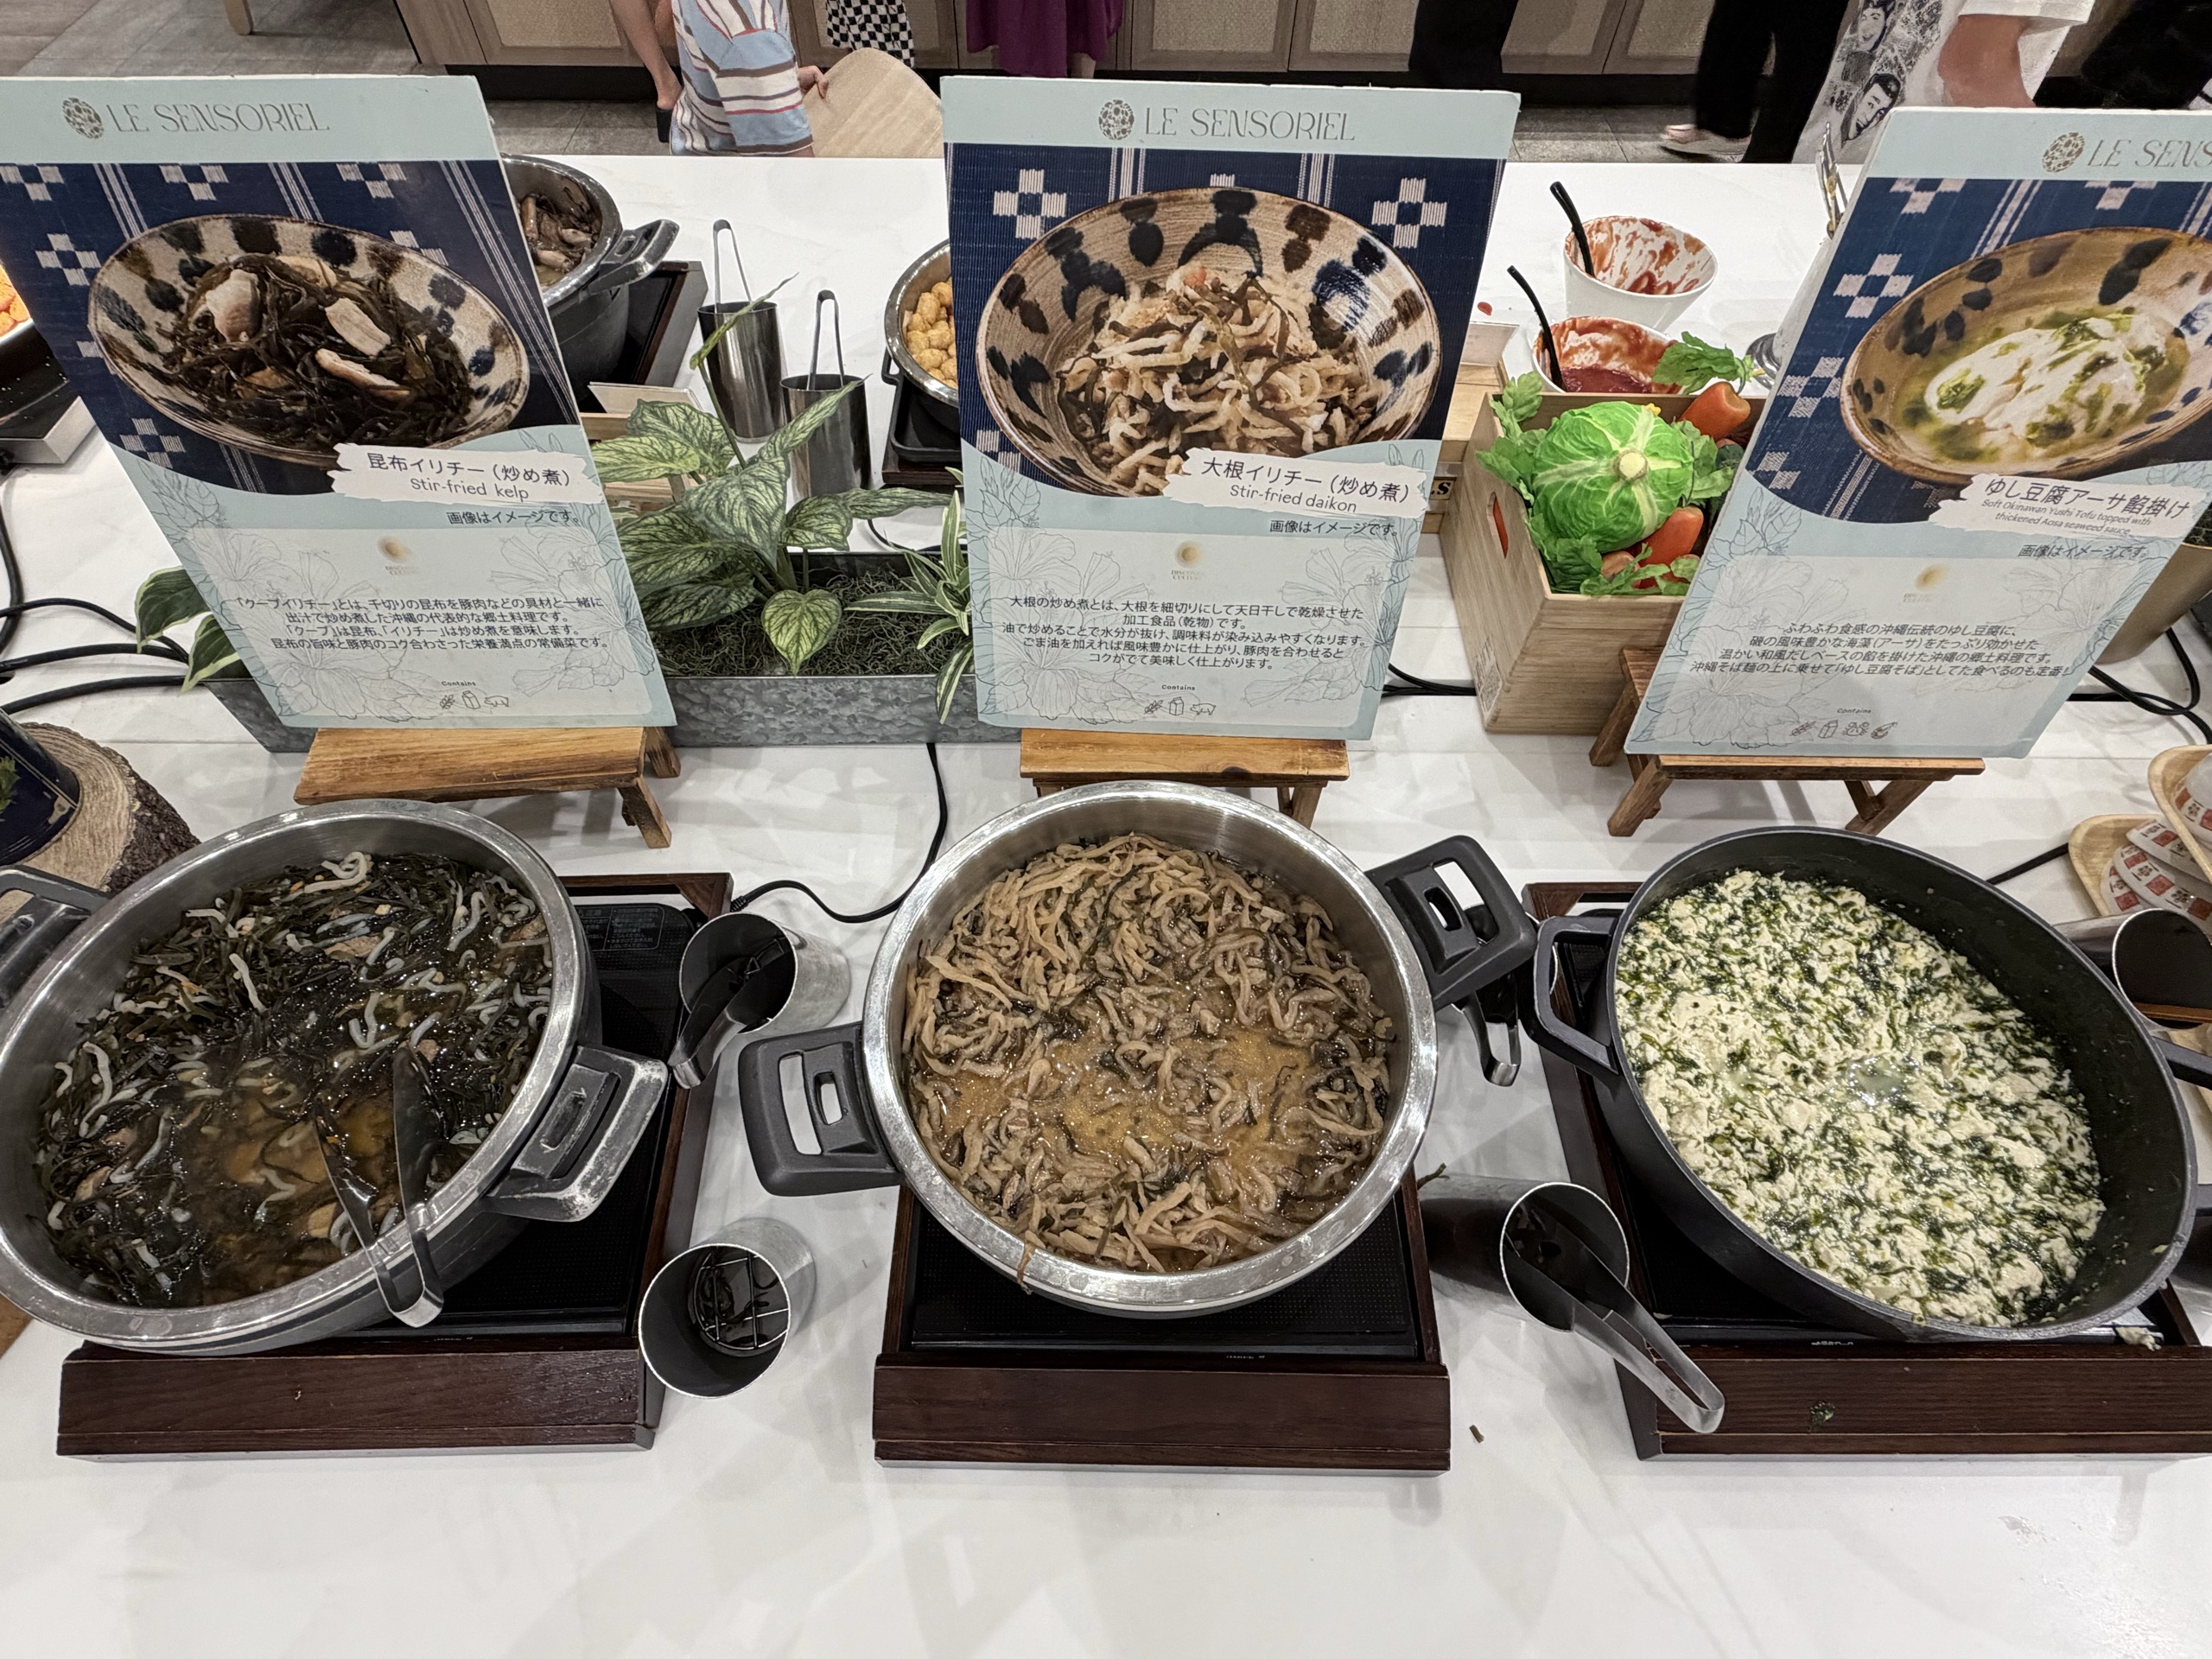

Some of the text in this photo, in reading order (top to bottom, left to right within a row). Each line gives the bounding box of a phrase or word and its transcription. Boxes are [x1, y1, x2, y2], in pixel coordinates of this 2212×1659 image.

[106, 103, 330, 132] LE SENSORIEL
[1146, 107, 1355, 141] LE SENSORIEL
[2088, 139, 2132, 167] LE
[367, 452, 570, 486] 昆布イリチー（炒め煮）
[1202, 456, 1409, 504] 大根イリチー（炒め煮）
[410, 478, 529, 502] Stir-fried kelp
[1230, 485, 1357, 513] Stir-fried daikon
[1985, 478, 2190, 518] ゆし豆腐アーサ餡掛け
[446, 512, 580, 524] 画像はイメージです。
[1981, 499, 2003, 508] Soft
[2002, 501, 2047, 513] Okinawan
[1269, 519, 1397, 537] 画像はイメージです。
[2018, 544, 2148, 559] 画像はイメージです。
[1010, 596, 1363, 620] 大根の炒め煮とは、大根を細切りにして天日干しで乾燥させた
